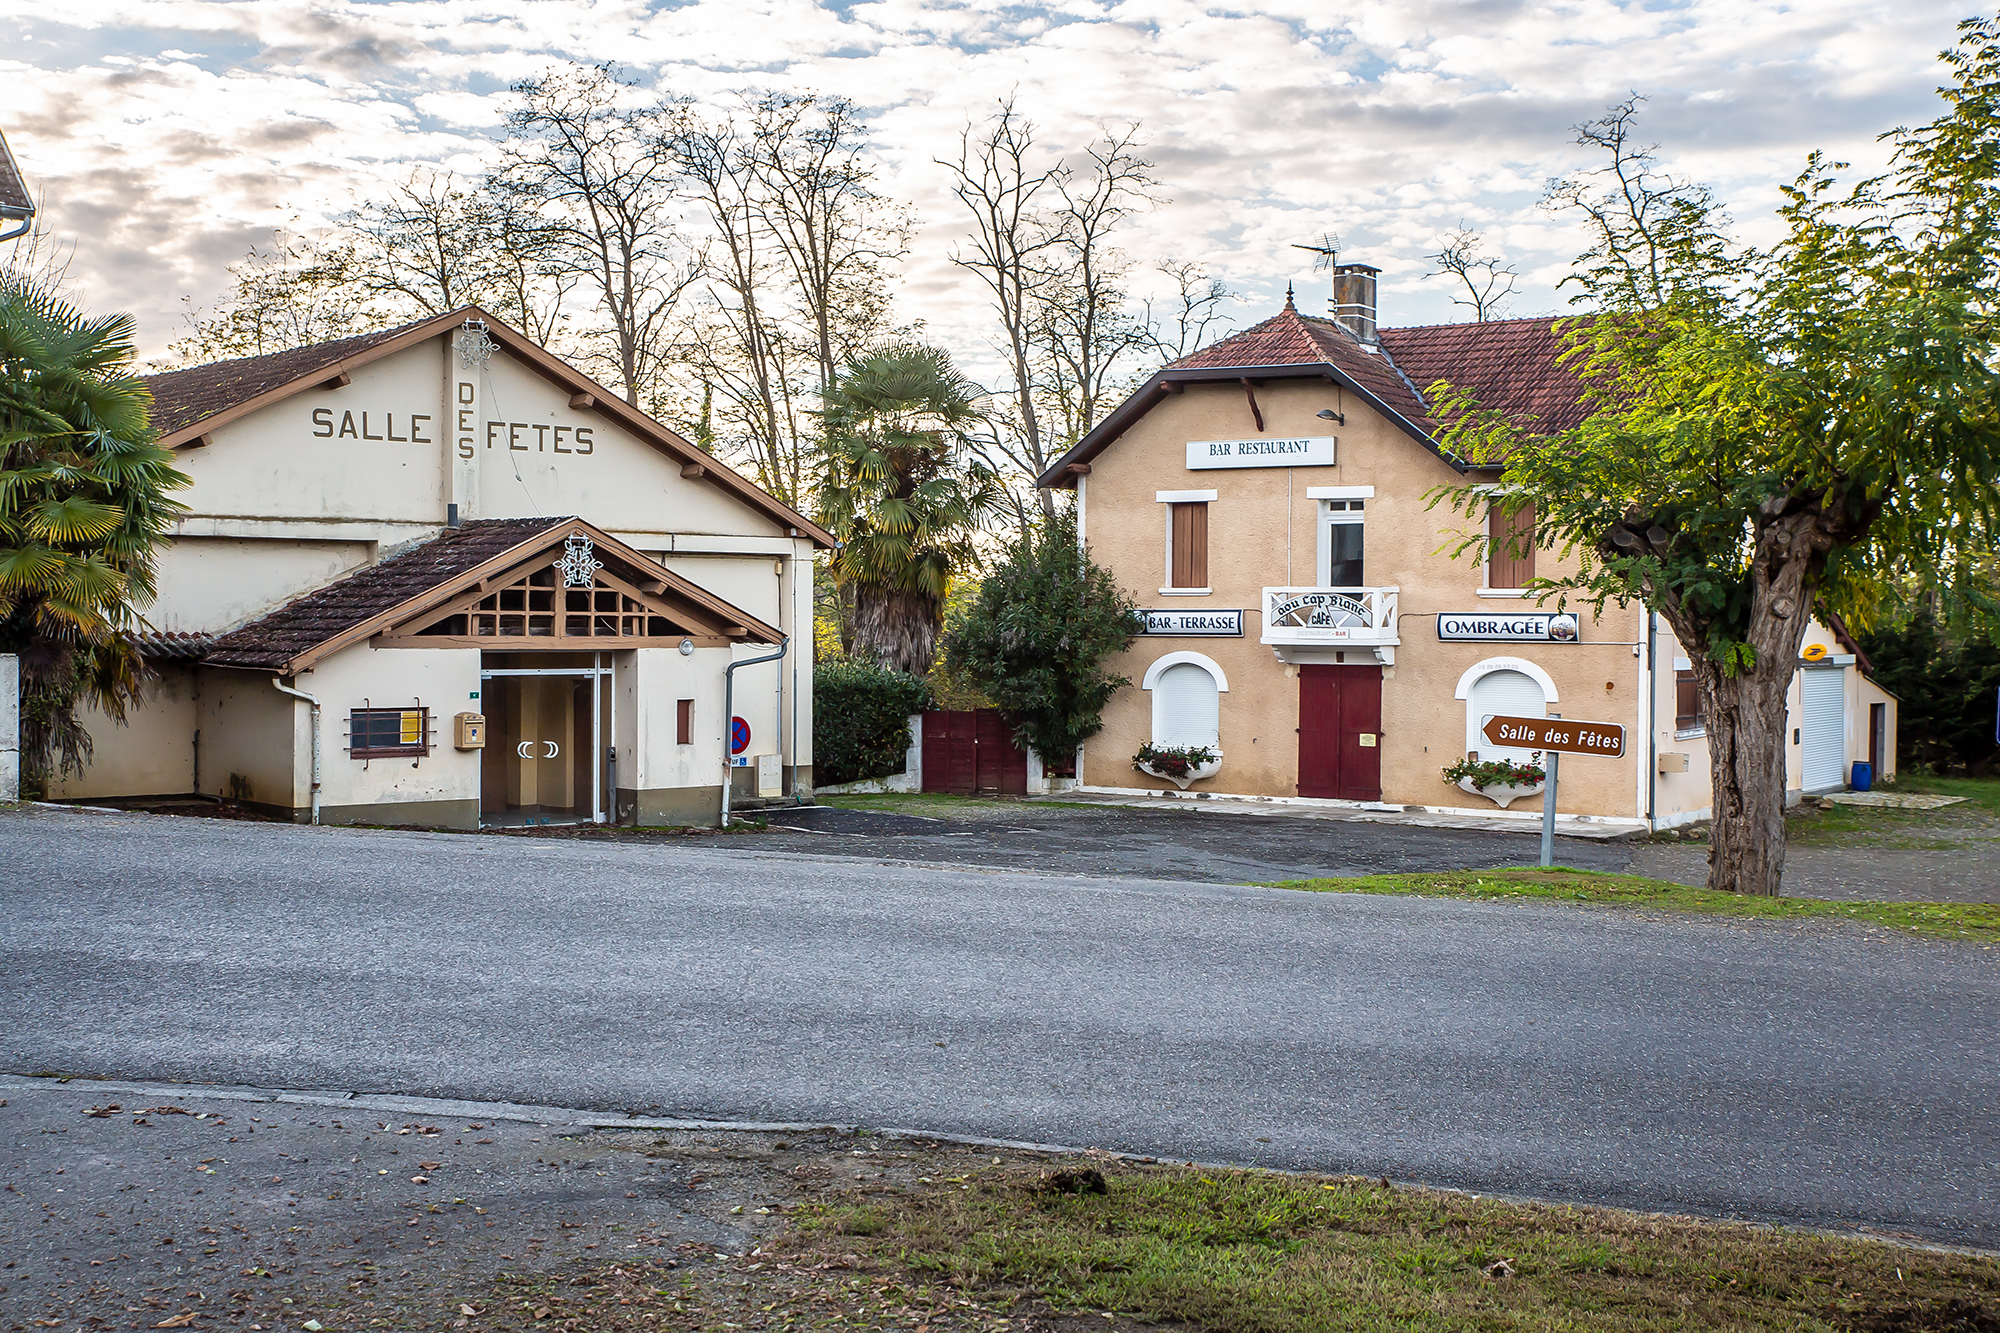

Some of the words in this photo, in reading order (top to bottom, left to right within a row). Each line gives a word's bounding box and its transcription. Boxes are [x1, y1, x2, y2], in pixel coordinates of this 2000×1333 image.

[311, 407, 432, 444] SALLE
[458, 382, 474, 459] DES
[487, 420, 594, 455] FETES
[1209, 443, 1231, 456] BAR
[1238, 440, 1310, 455] RESTAURANT
[1329, 595, 1366, 616] Blanc
[1445, 618, 1544, 635] OMBRAGÉE
[1499, 723, 1536, 742] Salle
[1544, 727, 1570, 744] des
[1578, 730, 1620, 749] Fêtes
